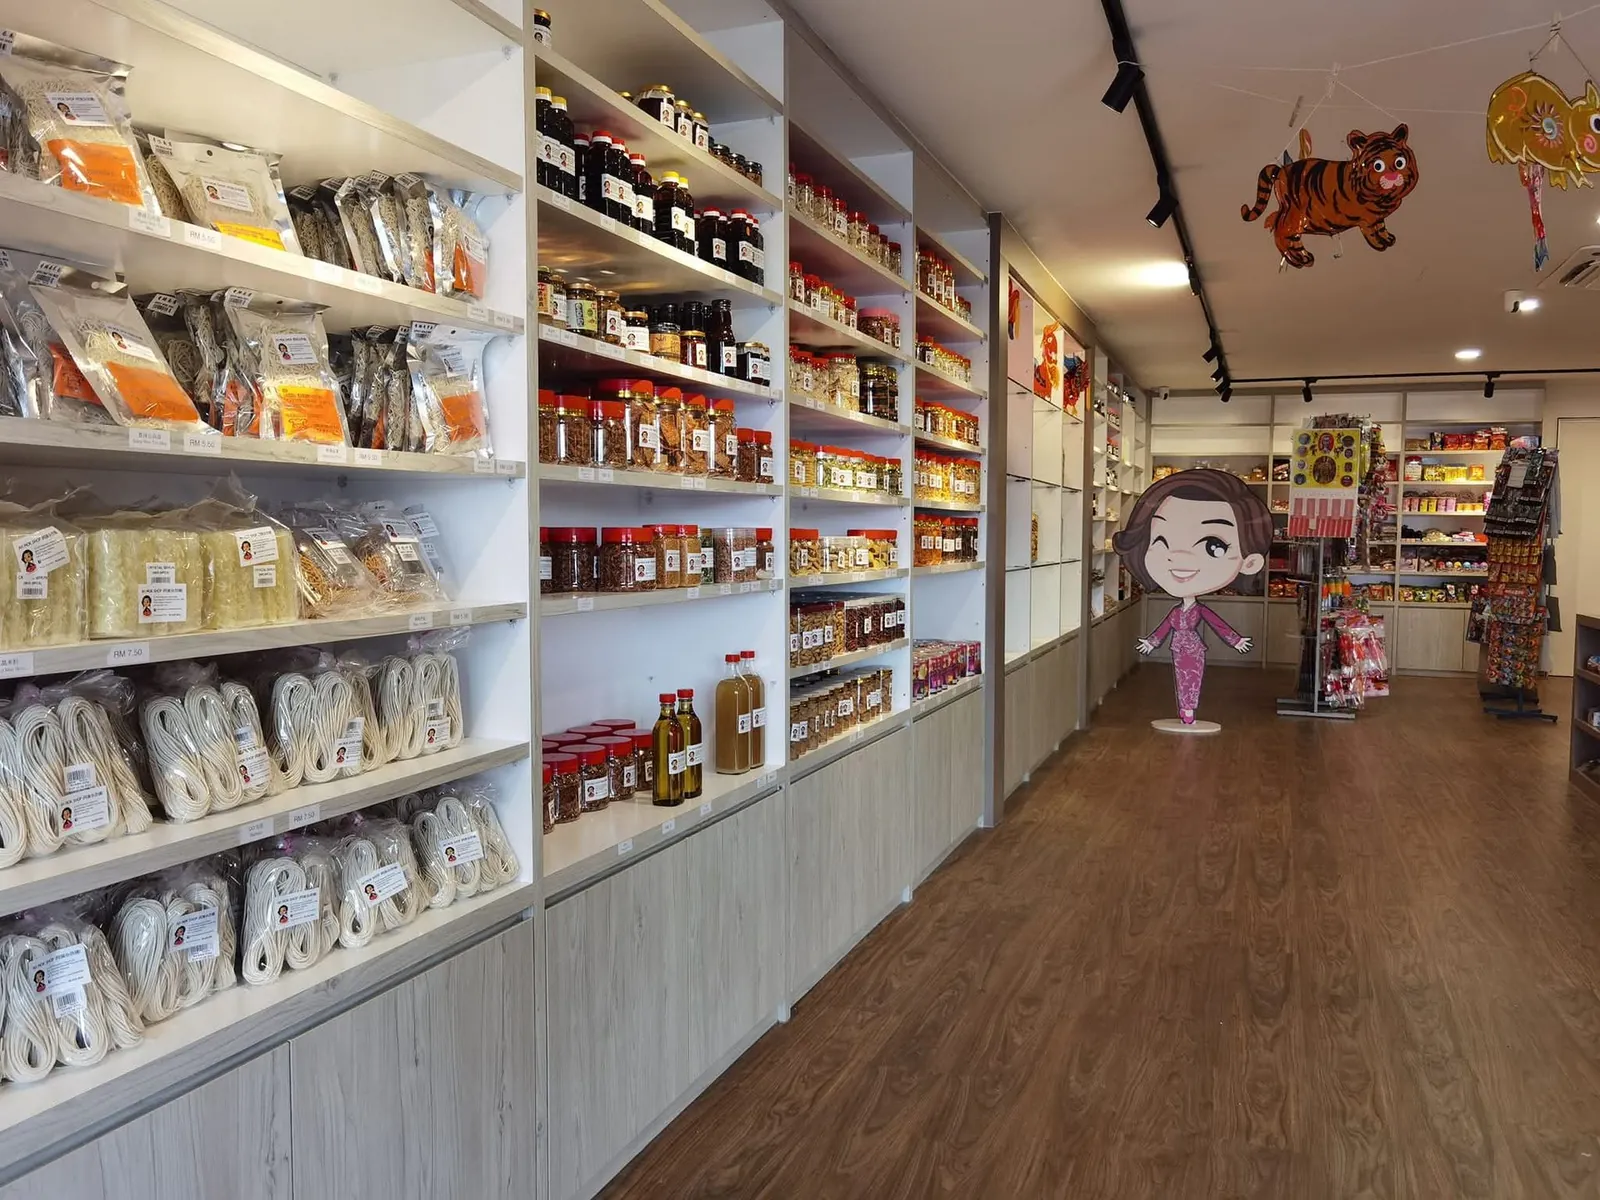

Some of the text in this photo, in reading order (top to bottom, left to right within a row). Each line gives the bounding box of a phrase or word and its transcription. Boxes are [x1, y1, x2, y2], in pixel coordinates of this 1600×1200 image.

[190, 231, 201, 240] RM
[189, 439, 201, 447] RM
[113, 648, 143, 658] RM 7.50
[293, 811, 315, 822] RM 7.50
